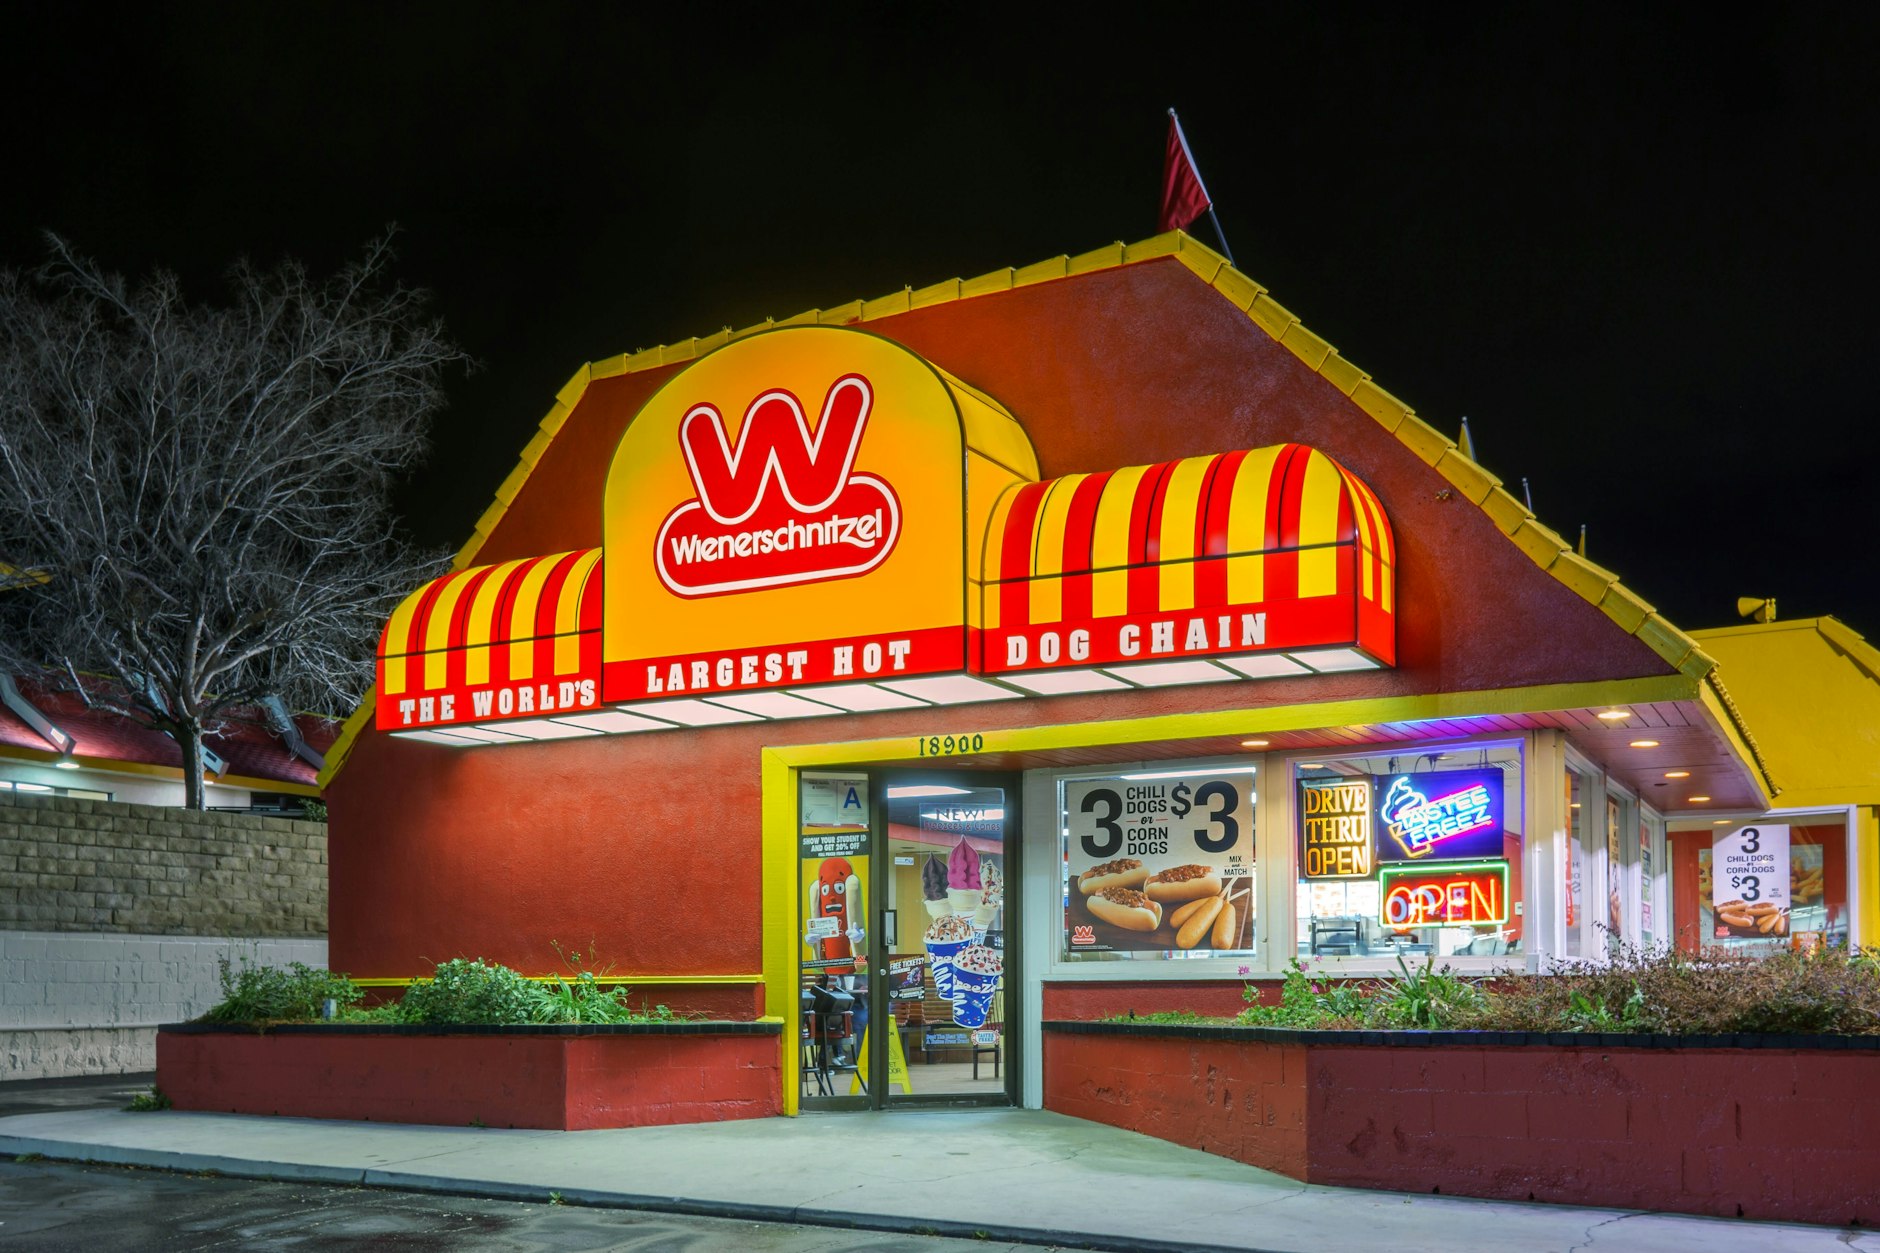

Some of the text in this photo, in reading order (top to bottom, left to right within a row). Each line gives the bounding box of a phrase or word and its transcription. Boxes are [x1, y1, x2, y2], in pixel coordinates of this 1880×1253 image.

[680, 376, 872, 526] W
[671, 508, 883, 566] Wienerschnitzel
[1006, 612, 1267, 667] DOG CHAIN
[646, 639, 912, 694] LARGEST HOT
[399, 679, 597, 725] THE WORLD'S
[919, 733, 984, 757] 18900
[843, 787, 862, 809] A
[1126, 785, 1165, 800] CHILI
[1305, 785, 1367, 815] DRIVE
[935, 808, 985, 821] NEW!
[1126, 799, 1167, 814] DOGS
[1170, 781, 1239, 853] $3
[1395, 787, 1491, 830] TASTEE
[974, 822, 1000, 831] Cones
[1080, 788, 1123, 858] 3
[1140, 816, 1154, 825] or
[1305, 814, 1367, 844] THRU
[1409, 805, 1492, 847] FREEZ
[802, 834, 867, 846] SHOW YOUR STUDENT ID
[811, 842, 860, 852] AND GET 20% OFF
[1127, 827, 1168, 841] CORN
[1741, 828, 1760, 854] 3
[1127, 841, 1168, 856] DOGS
[1306, 846, 1367, 876] OPEN
[1727, 855, 1749, 863] CHILI
[1224, 868, 1248, 876] MATCH
[1726, 866, 1750, 874] CORN
[1731, 875, 1760, 902] $3
[1386, 878, 1496, 928] OPEN
